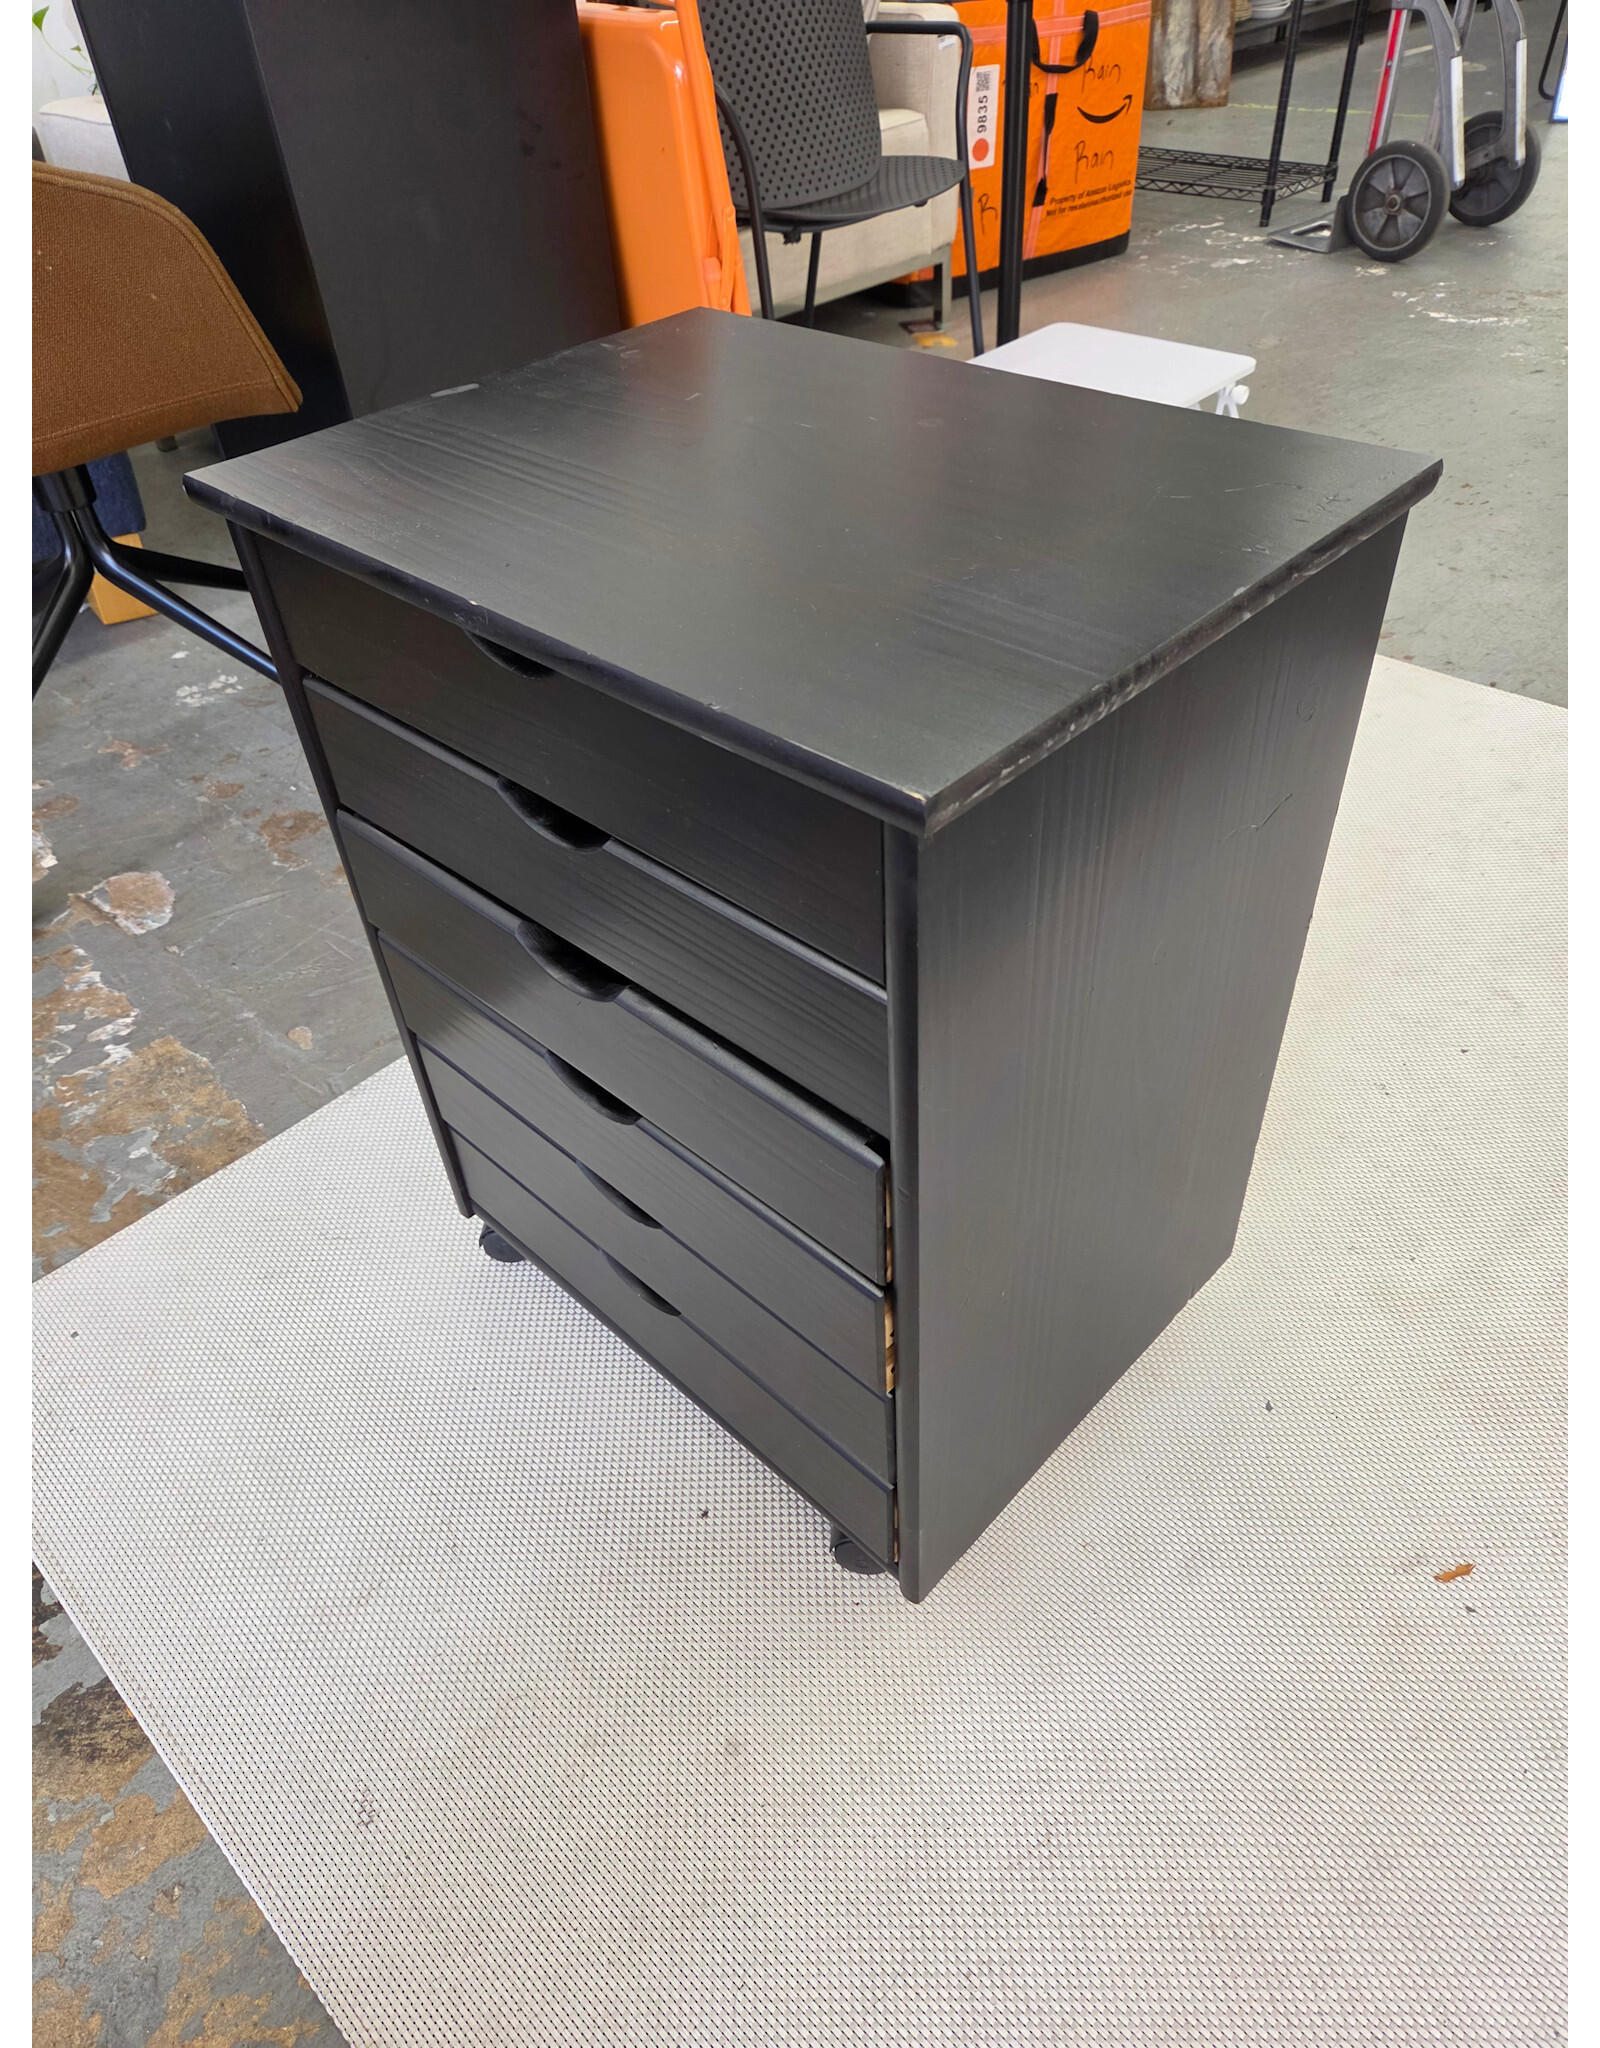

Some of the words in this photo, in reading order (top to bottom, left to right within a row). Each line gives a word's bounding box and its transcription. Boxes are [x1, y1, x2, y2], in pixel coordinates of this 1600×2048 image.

[977, 95, 988, 133] 9835
[1050, 194, 1076, 205] Property
[1077, 189, 1086, 199] of
